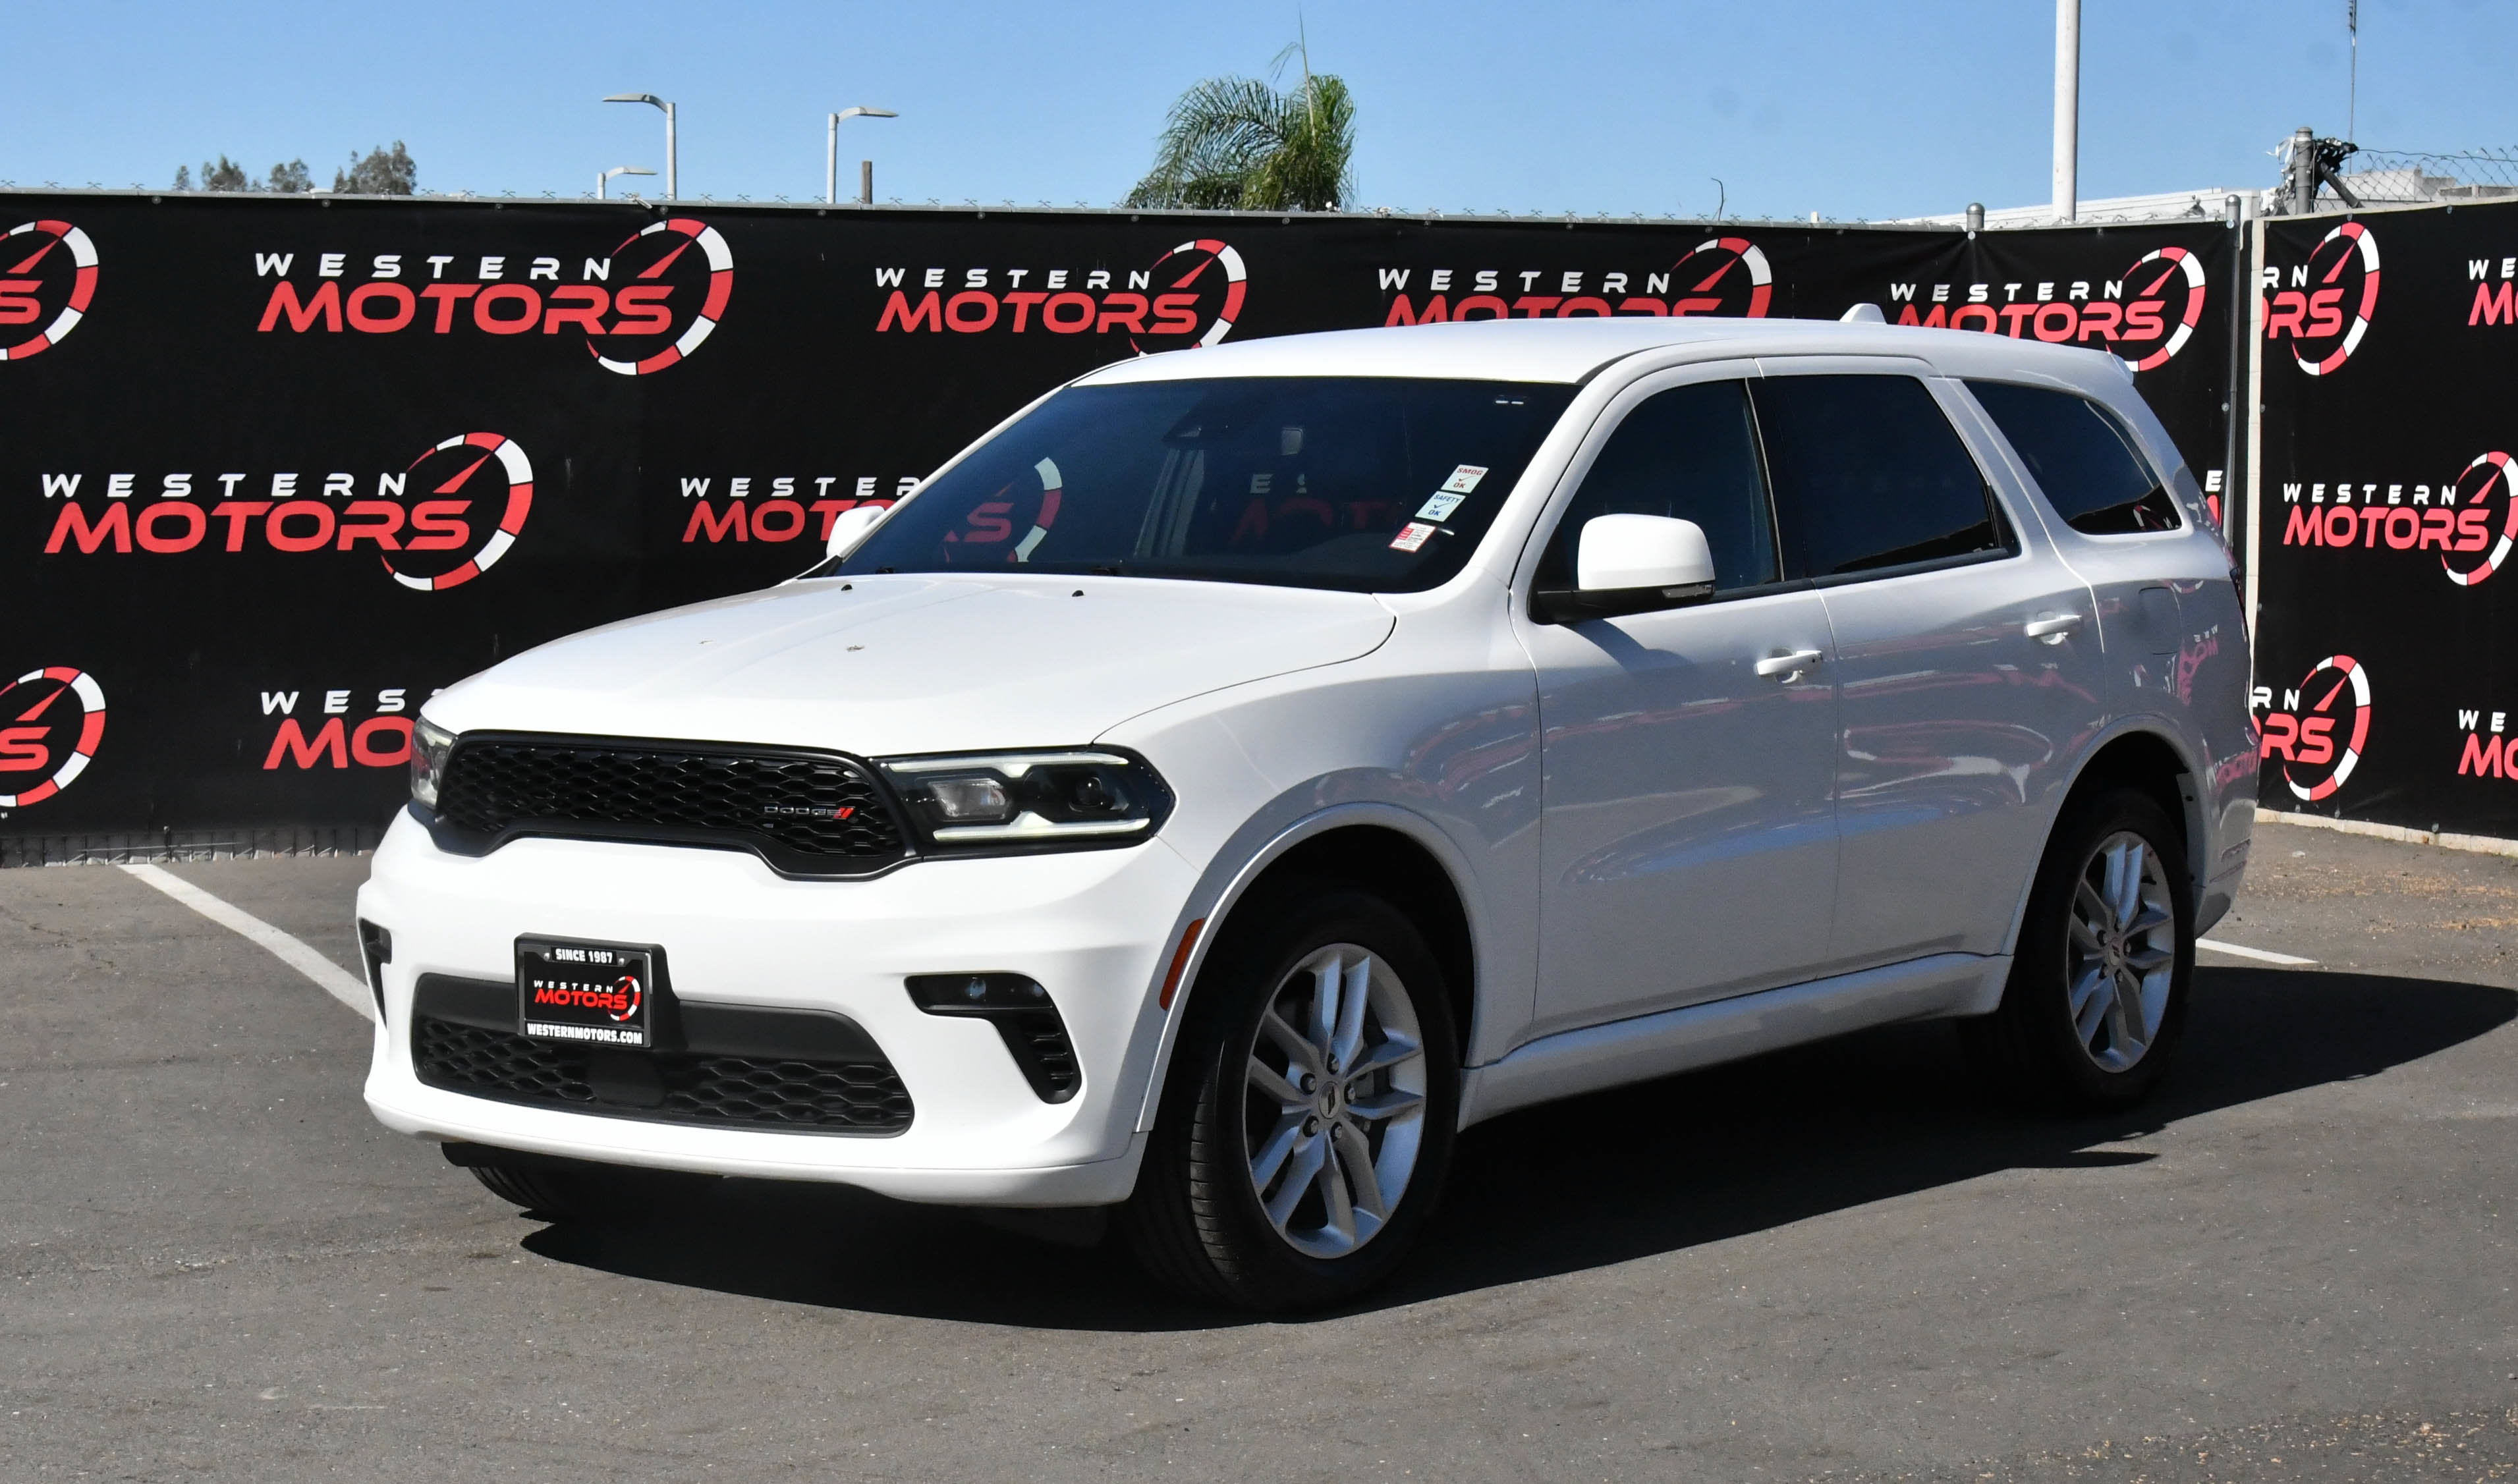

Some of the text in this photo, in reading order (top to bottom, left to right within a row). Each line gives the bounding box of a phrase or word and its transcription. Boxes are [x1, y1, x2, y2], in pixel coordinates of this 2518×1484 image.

[255, 253, 611, 281] WESTERN
[876, 267, 1150, 289] WESTERN
[1378, 268, 1670, 294] WESTERN
[1890, 280, 2123, 302] WESTERN
[258, 281, 675, 335] MOTORS
[876, 290, 1200, 334] MOTORS
[42, 472, 406, 498] WESTERN
[2283, 483, 2457, 506] WESTERN
[1434, 494, 1461, 503] SAFETY
[44, 500, 472, 554] MOTORS
[2283, 505, 2491, 552] MOTORS
[764, 806, 841, 816] DODGE
[555, 948, 613, 964] SINCE 1987
[534, 979, 613, 993] WESTERN
[534, 989, 628, 1010] MOTORS
[526, 1022, 643, 1045] WESTERNMOTORS.COM
